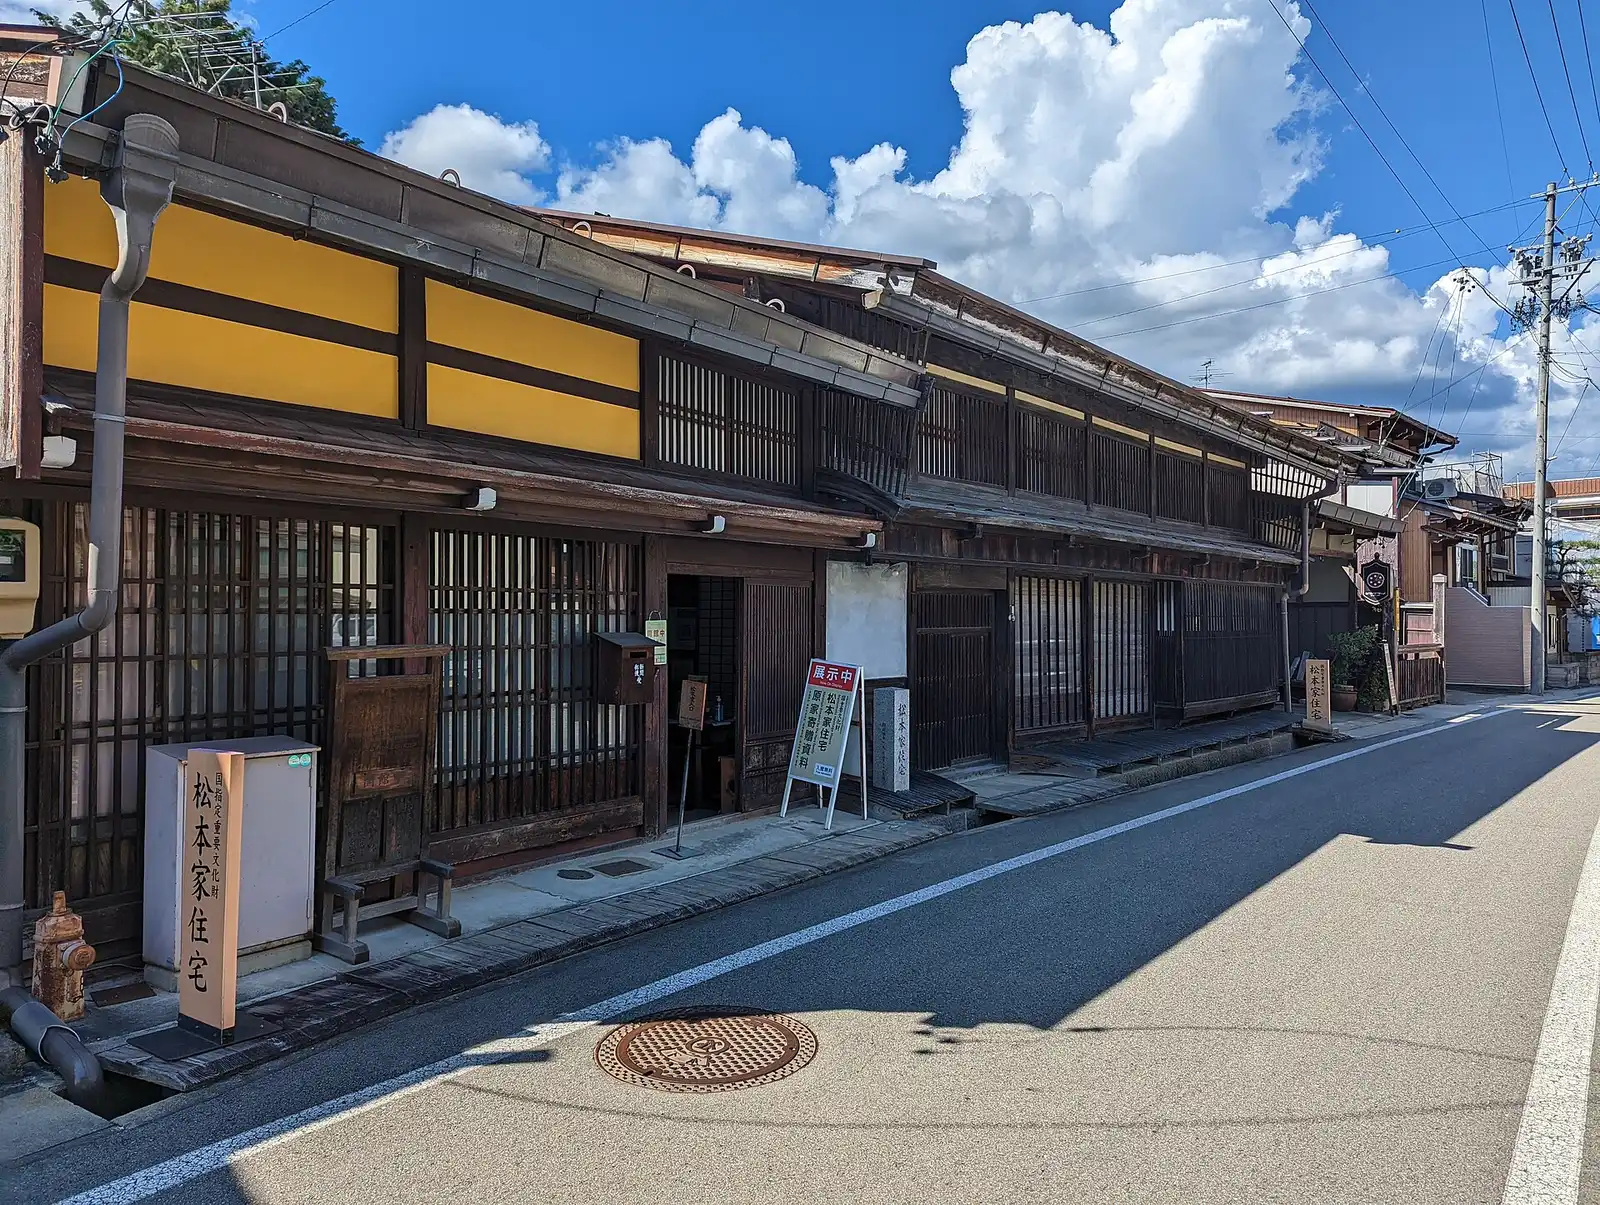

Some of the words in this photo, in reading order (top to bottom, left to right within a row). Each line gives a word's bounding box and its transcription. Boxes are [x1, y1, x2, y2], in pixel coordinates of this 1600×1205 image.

[813, 665, 852, 683] 展示中
[1309, 664, 1322, 720] 松本家住宅
[799, 689, 821, 769] 原家寄贈資料
[818, 692, 836, 752] 松本家住宅
[211, 772, 223, 900] 国指定重要文化財
[188, 771, 214, 993] 松本家住宅
